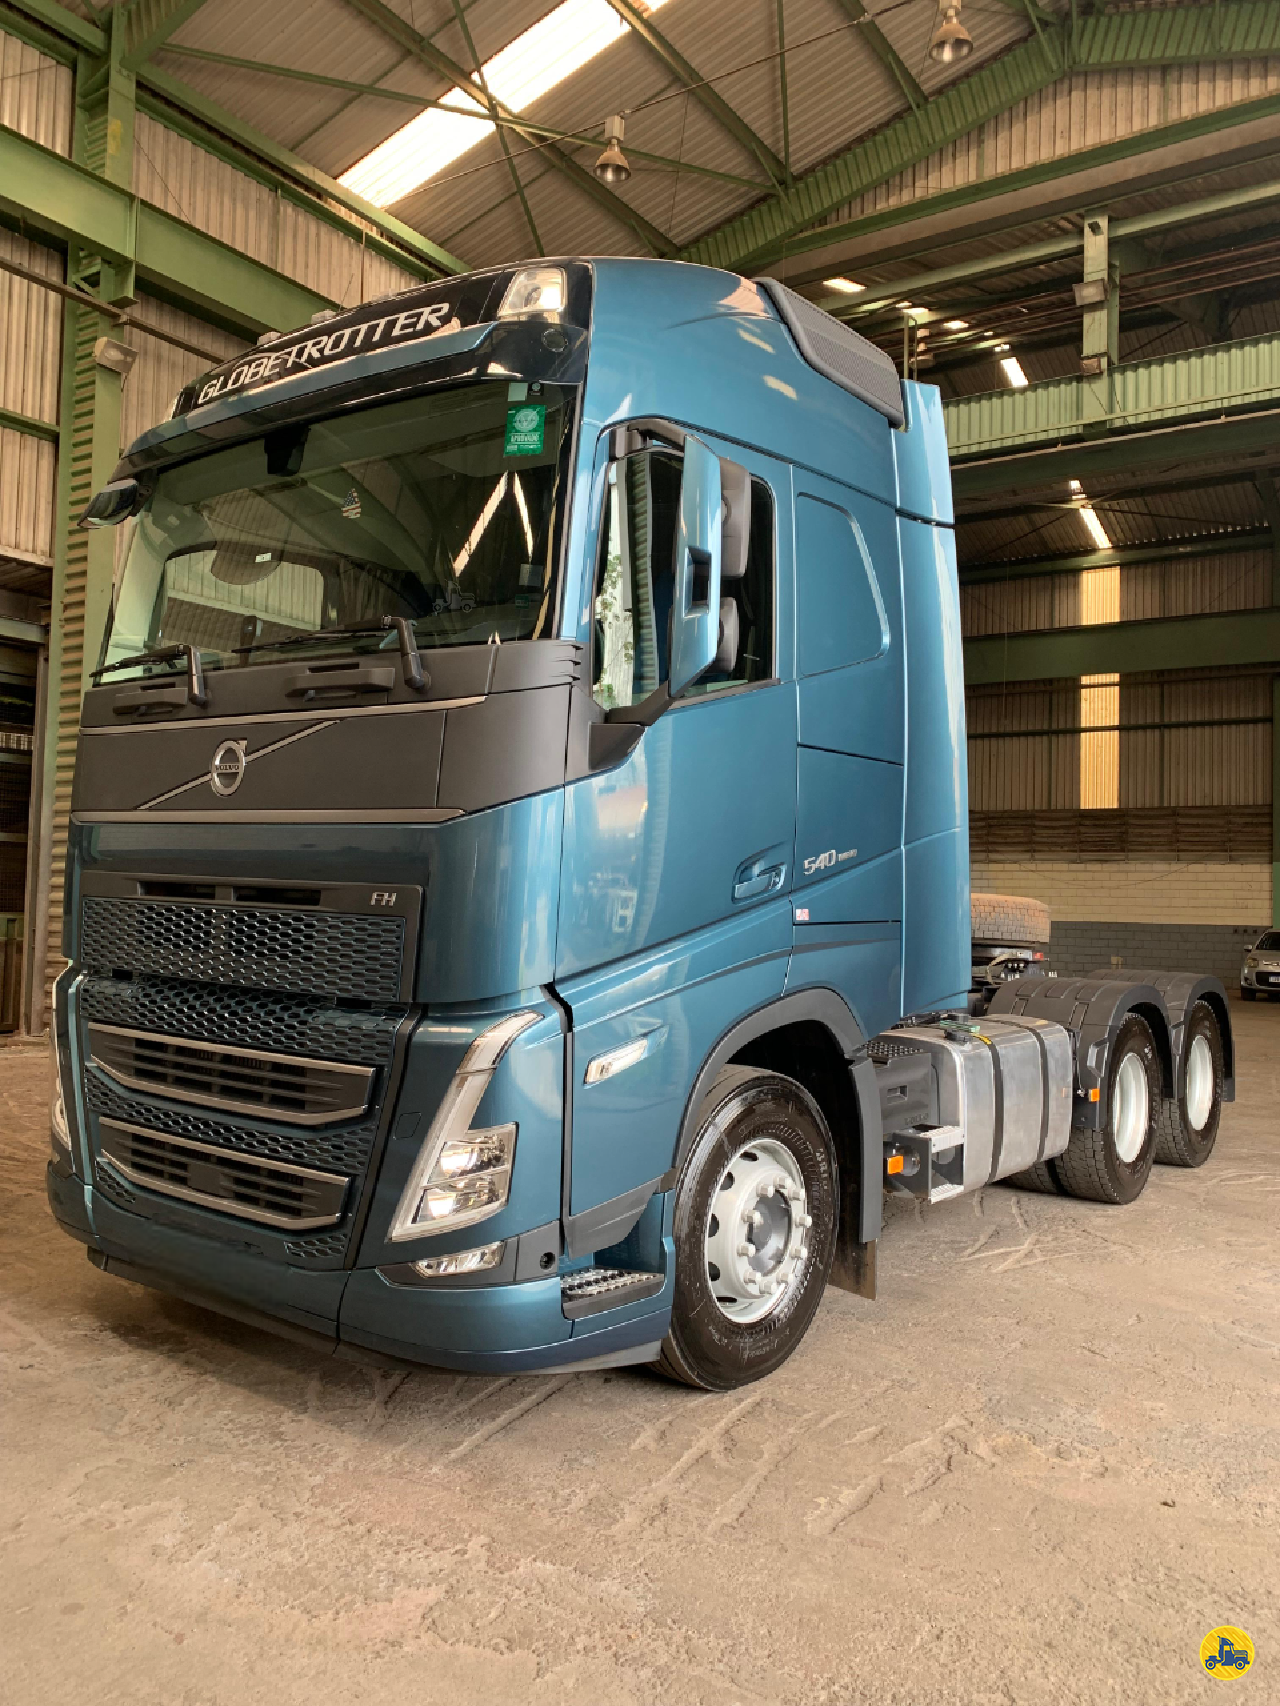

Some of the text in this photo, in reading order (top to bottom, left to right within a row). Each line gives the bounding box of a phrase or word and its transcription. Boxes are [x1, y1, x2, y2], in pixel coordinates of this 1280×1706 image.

[199, 303, 449, 404] GLOBETROTTER
[803, 849, 836, 875] 540
[370, 892, 397, 906] FH
